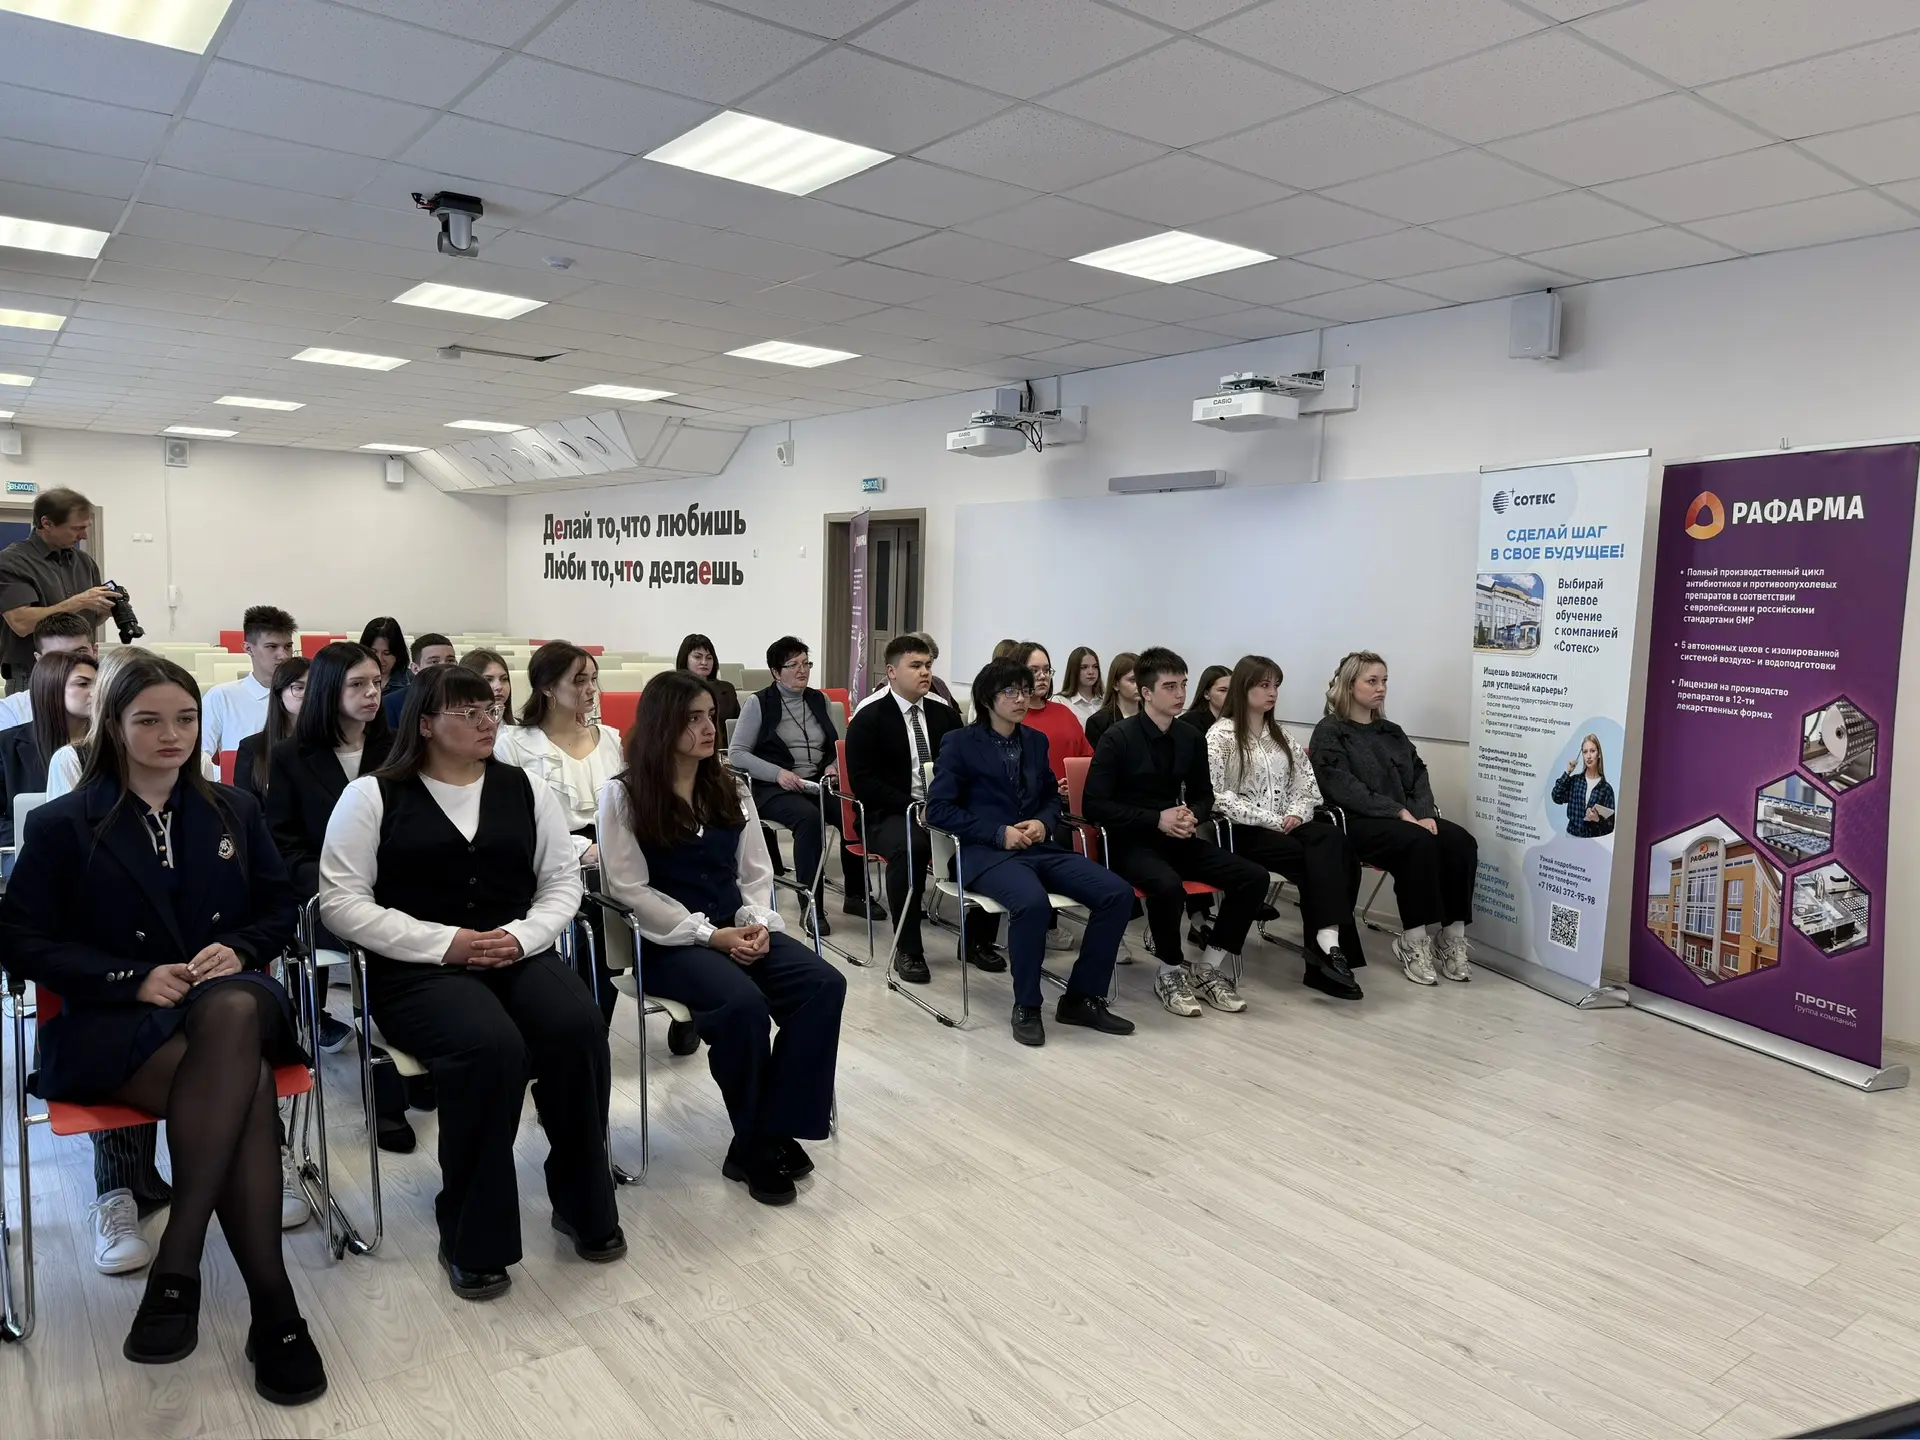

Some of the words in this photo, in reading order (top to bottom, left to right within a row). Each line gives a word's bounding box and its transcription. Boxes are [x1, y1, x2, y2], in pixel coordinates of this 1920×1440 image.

[1213, 397, 1233, 405] CASIO
[9, 483, 35, 492] ВЫХОД
[1514, 493, 1556, 507] СОТЕКС
[1732, 495, 1865, 525] РАФАРМА
[543, 511, 592, 545] Делай
[597, 515, 650, 545] то,что
[656, 502, 746, 538] любишь
[1506, 524, 1568, 542] СДЕЛАЙ
[1571, 526, 1607, 539] ШАГ
[1491, 548, 1499, 560] В
[1503, 547, 1541, 560] СВОЕ
[1544, 543, 1625, 560] БУДУЩЕЕ!
[544, 551, 586, 580] Люби
[591, 560, 644, 588] то,что
[649, 560, 744, 589] делаешь
[1687, 568, 1718, 577] Полный
[1720, 567, 1800, 577] производственный
[1801, 569, 1825, 577] цикл
[1558, 578, 1604, 592] Выбирай
[1686, 580, 1741, 588] антибиотиков
[1749, 581, 1837, 590] противоопухолевых
[1557, 596, 1598, 606] целевое
[1685, 592, 1731, 601] препаратов
[1739, 593, 1796, 601] соответствии
[1690, 604, 1748, 613] европейскими
[1757, 605, 1815, 614] российскими
[1555, 610, 1602, 623] обучение
[1683, 616, 1734, 625] стандартами
[1735, 616, 1755, 624] GMP
[1554, 627, 1560, 635] с
[1561, 627, 1618, 639] компанией
[1553, 640, 1600, 653] «Сотекс»
[1681, 640, 1686, 649] 5
[1687, 643, 1737, 652] автономных
[1738, 646, 1763, 654] цехов
[1771, 647, 1840, 658] изолированной
[1680, 654, 1718, 663] системой
[1719, 656, 1755, 665] воздухо-
[1764, 659, 1836, 671] водоподготовки
[1483, 667, 1510, 677] Ищешь
[1511, 670, 1558, 681] возможности
[1482, 680, 1495, 688] для
[1496, 681, 1530, 692] успешной
[1531, 685, 1568, 696] карьеры?
[1678, 678, 1718, 690] Лицензия
[1730, 685, 1789, 696] производство
[1677, 692, 1724, 702] препаратов
[1732, 695, 1755, 705] 12-ти
[1676, 703, 1738, 716] лекарственных
[1739, 708, 1773, 719] формах
[1540, 855, 1553, 864] Узнай
[1546, 882, 1562, 895] (926)
[1563, 888, 1596, 906] 372-95-98
[1795, 991, 1858, 1019] ПРОТЕК
[1794, 1004, 1819, 1017] группа
[1820, 1011, 1857, 1028] компаний
